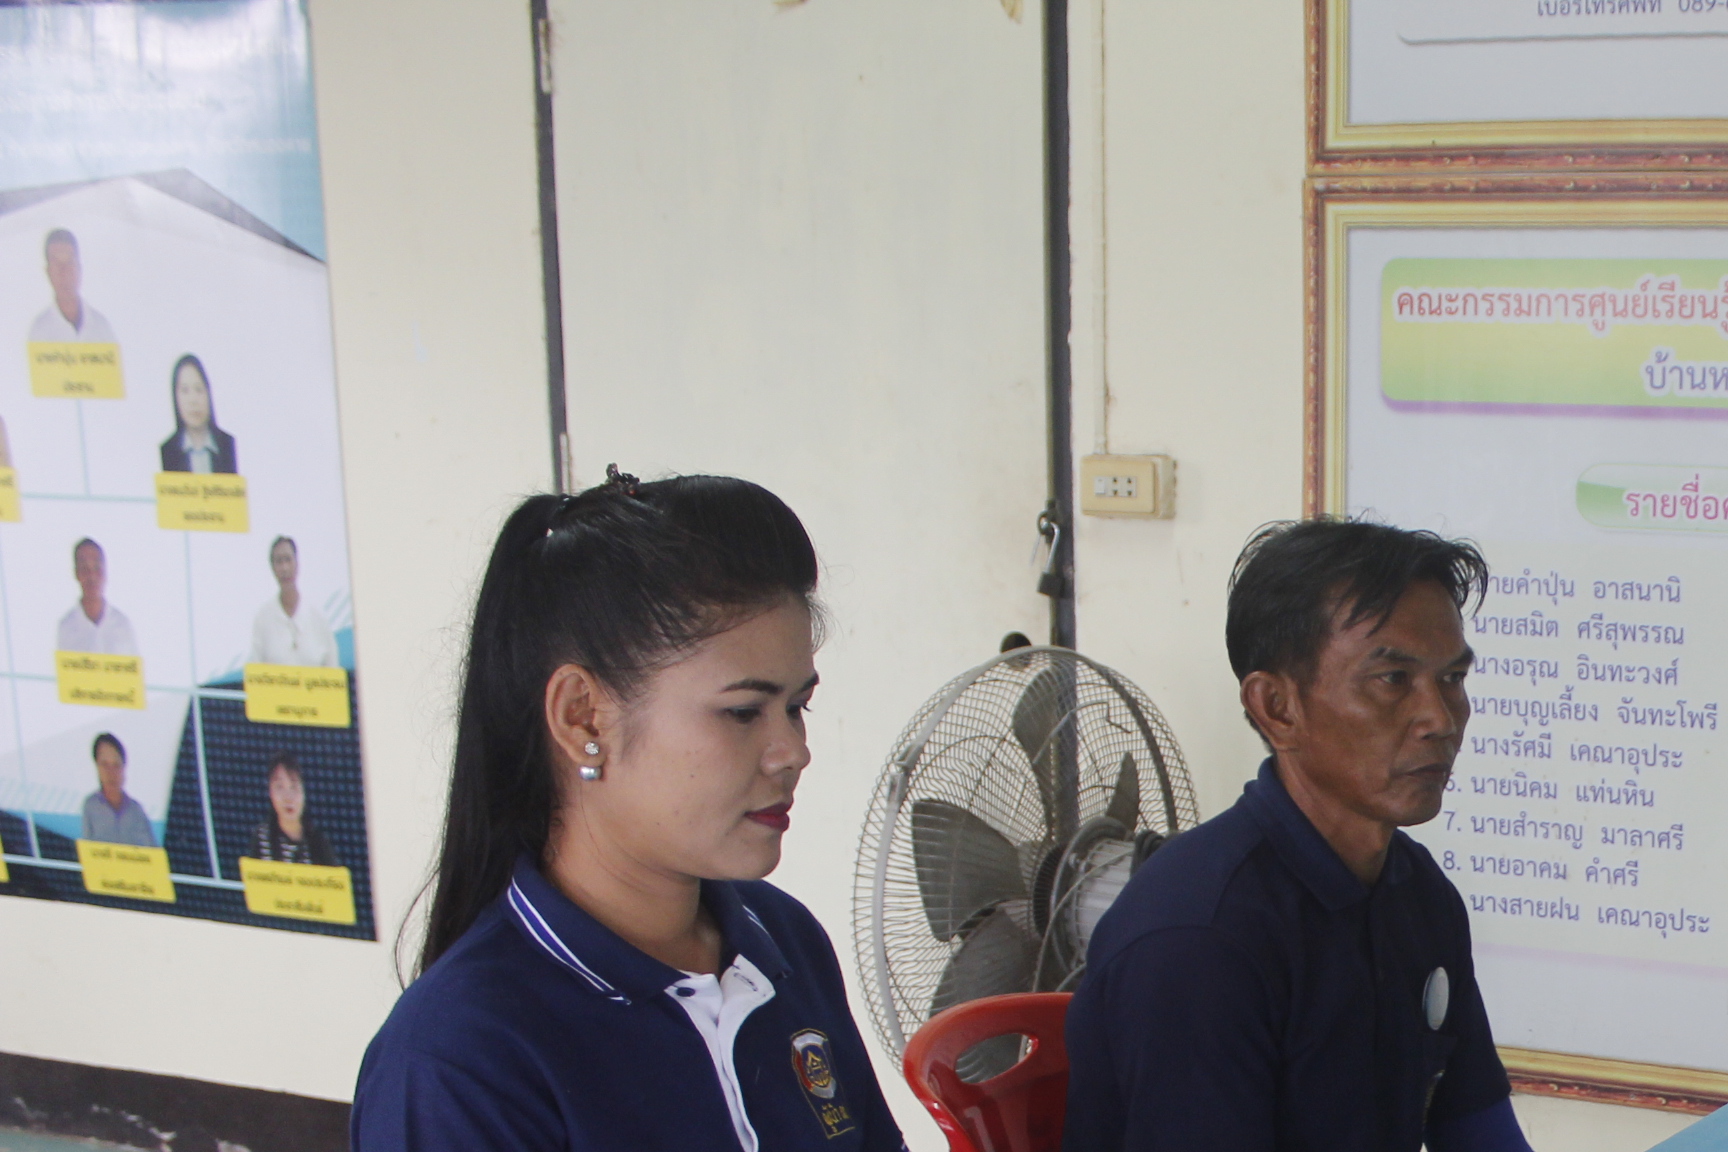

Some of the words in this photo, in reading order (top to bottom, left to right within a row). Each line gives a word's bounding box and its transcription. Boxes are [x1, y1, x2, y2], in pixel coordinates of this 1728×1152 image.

[1470, 567, 1575, 606] ายคำปุ่น
[1593, 576, 1680, 603] อาสนานิ
[1473, 610, 1559, 638] นายสมิต
[1578, 613, 1684, 650] ศรีสุพรรณ
[1473, 656, 1559, 687] นางอรุณ
[1577, 654, 1679, 686] อินทะวงศ์
[1473, 685, 1598, 726] นายบุญเลี้ยง
[1617, 697, 1717, 730] จันทะโพรี
[1471, 731, 1551, 759] นางรัศมี
[1571, 744, 1682, 775] เคณาอุประ
[1471, 772, 1557, 799] นายนิคม
[1576, 779, 1654, 807] แท่นหิน
[1444, 811, 1461, 832] 7.
[1471, 811, 1582, 849] นายสำราญ
[1601, 824, 1683, 850] มาลาศรี
[1443, 850, 1461, 871] 8.
[1470, 856, 1567, 880] นายอาคม
[1586, 857, 1638, 887] คำศรี
[1470, 895, 1579, 921] นางสายฝน
[1598, 907, 1709, 939] เคณาอุประ
